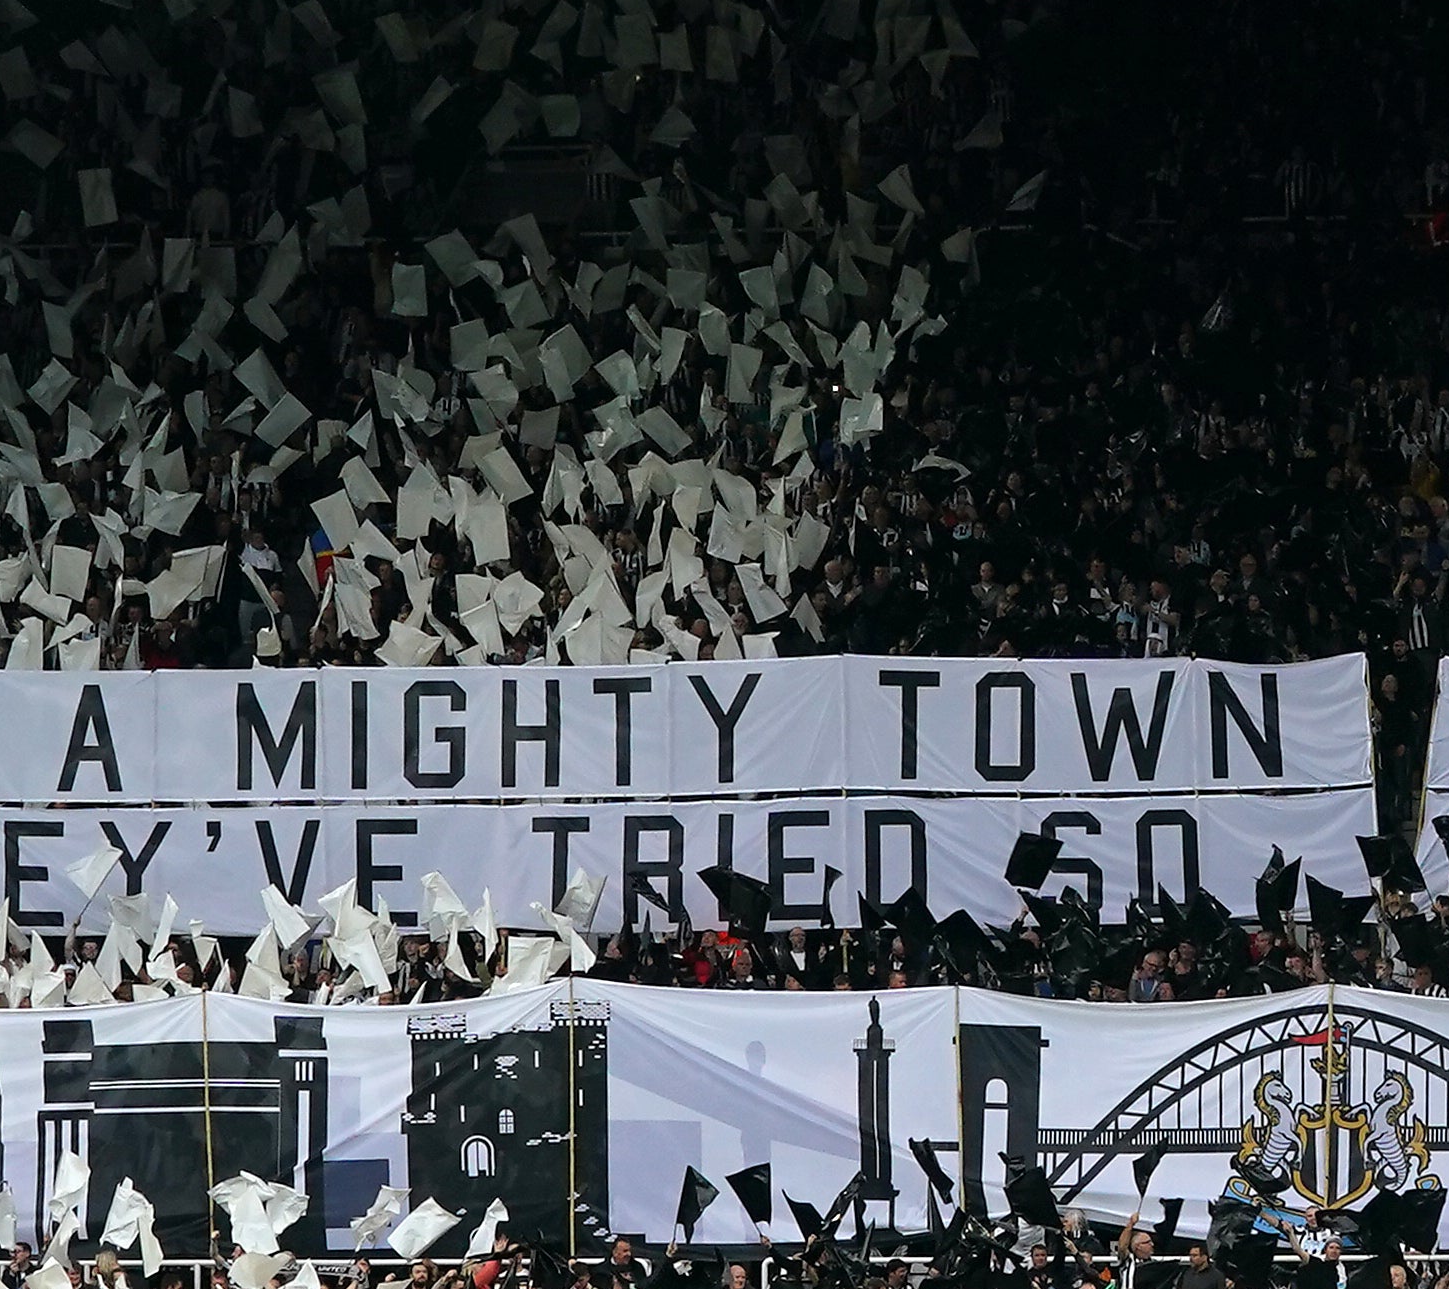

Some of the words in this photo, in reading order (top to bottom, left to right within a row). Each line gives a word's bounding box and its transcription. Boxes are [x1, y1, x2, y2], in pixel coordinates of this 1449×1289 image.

[57, 684, 122, 793] A
[236, 673, 763, 791] MIGHTY
[878, 670, 1284, 783] TOWN
[531, 809, 928, 927] TRIED
[1038, 808, 1202, 924] SO
